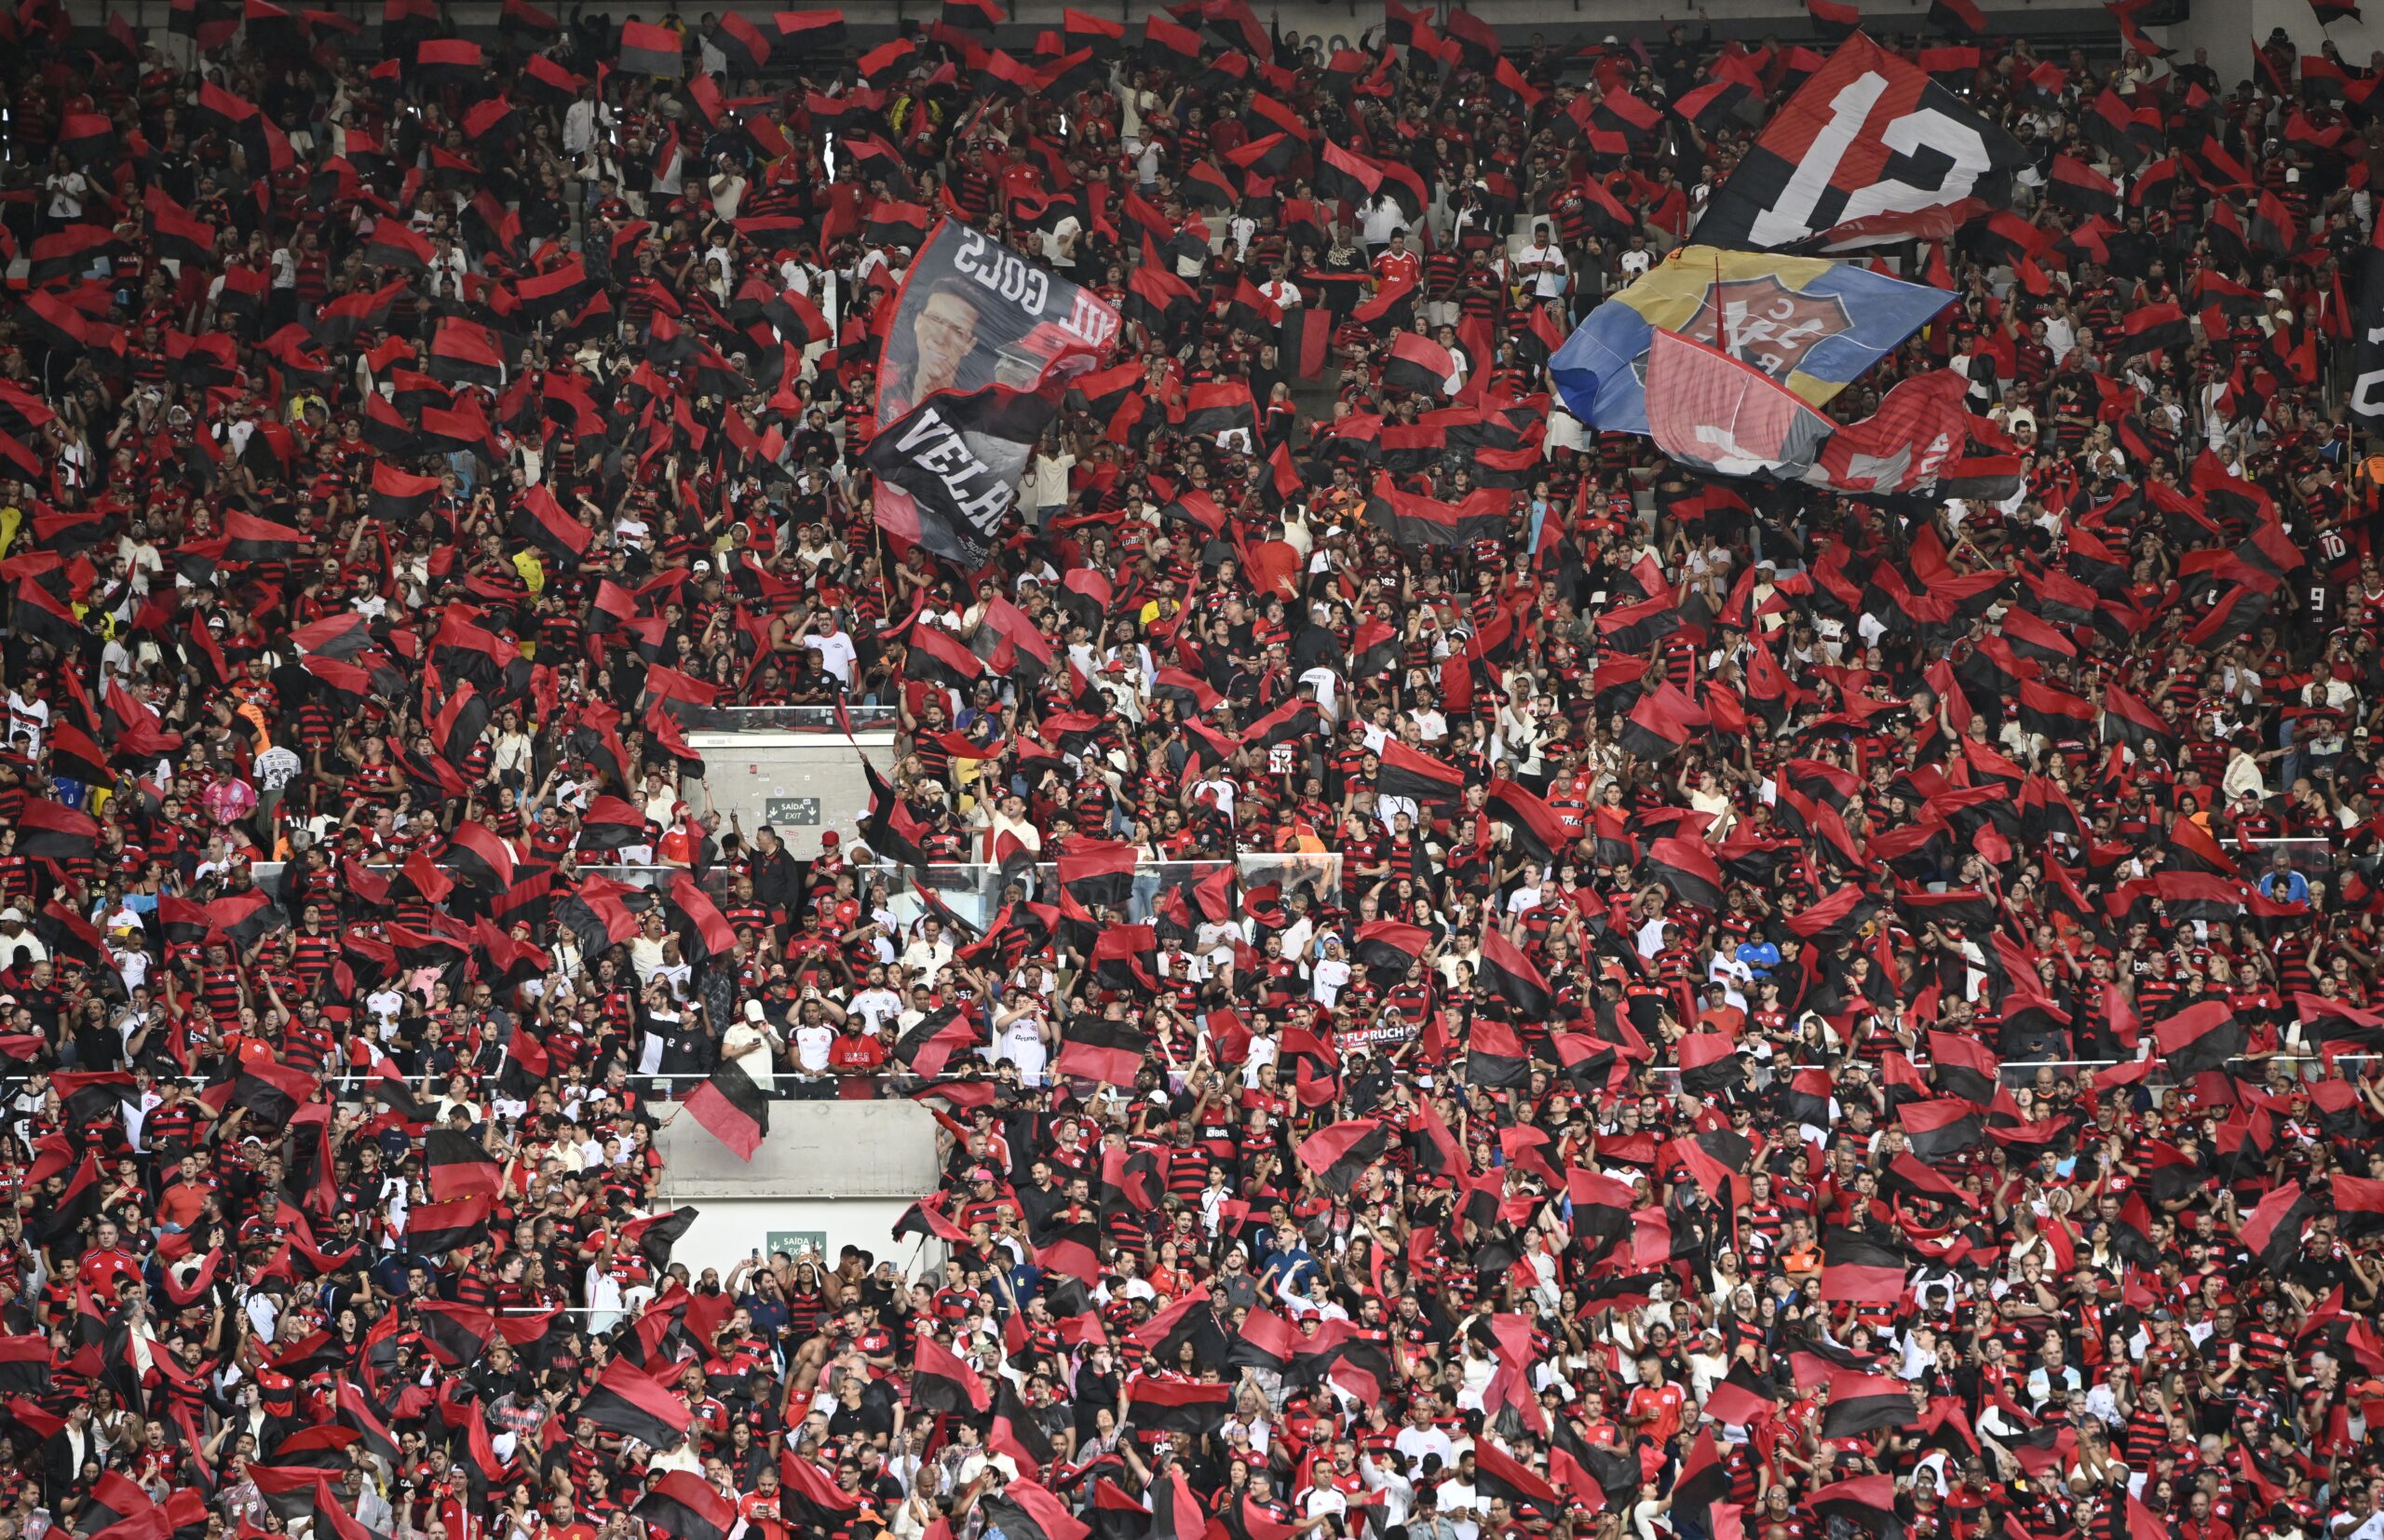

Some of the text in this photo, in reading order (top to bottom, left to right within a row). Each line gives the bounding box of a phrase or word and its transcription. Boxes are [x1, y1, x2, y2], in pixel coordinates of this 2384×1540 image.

[1748, 70, 1991, 247] 12
[2323, 535, 2346, 561] 10
[2310, 588, 2324, 611] 9
[13, 722, 35, 733] LUBRAX
[781, 803, 805, 811] SAÍDA
[1348, 1027, 1403, 1042] FLARUCH
[667, 1038, 675, 1047] 12
[783, 1236, 809, 1246] SAÍDA
